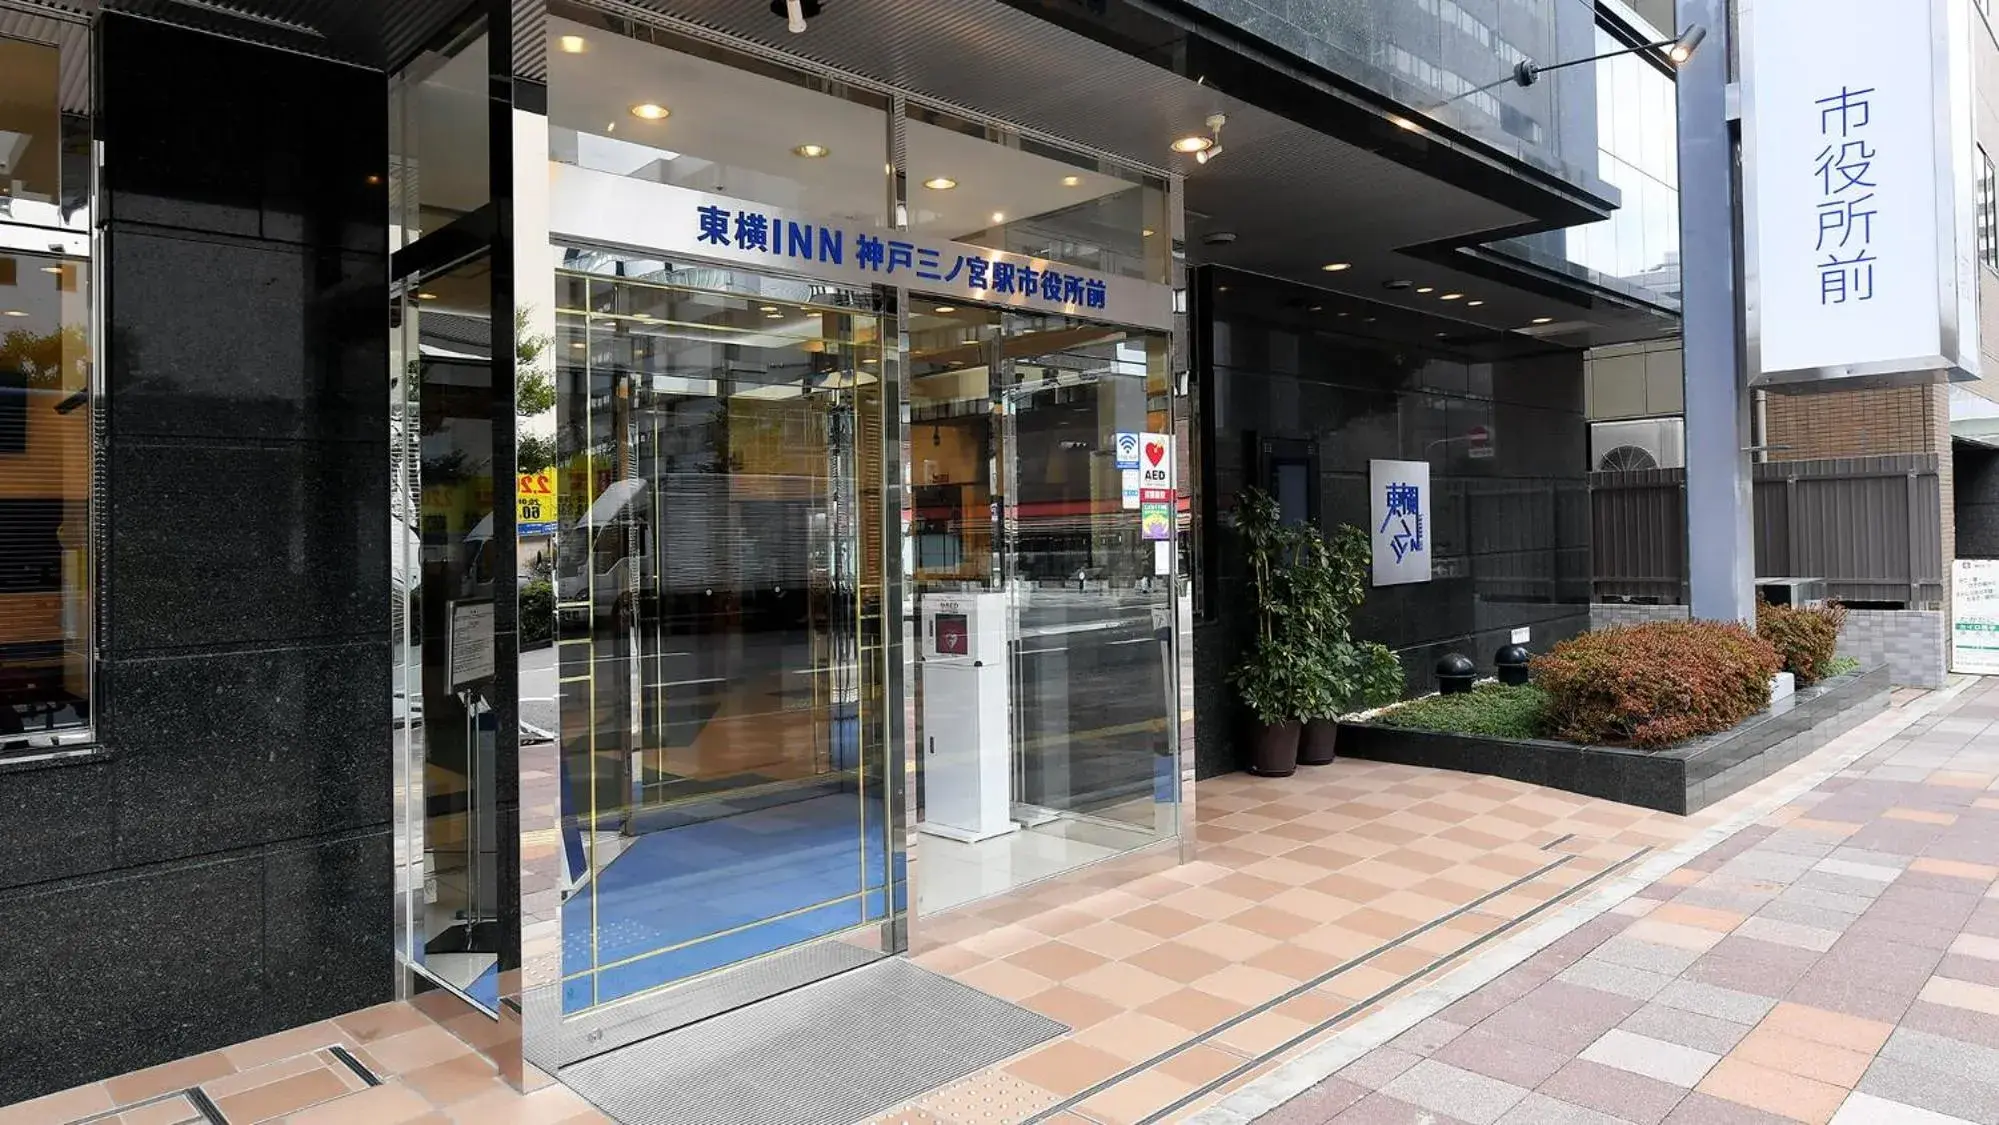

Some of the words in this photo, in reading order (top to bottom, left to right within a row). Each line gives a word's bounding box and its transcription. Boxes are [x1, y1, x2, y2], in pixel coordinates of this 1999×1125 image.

[1814, 86, 1878, 305] 市役所前
[697, 205, 843, 265] 東横INN
[856, 232, 1108, 310] 神戸三ノ宮駅市役所前
[1144, 470, 1166, 481] AED
